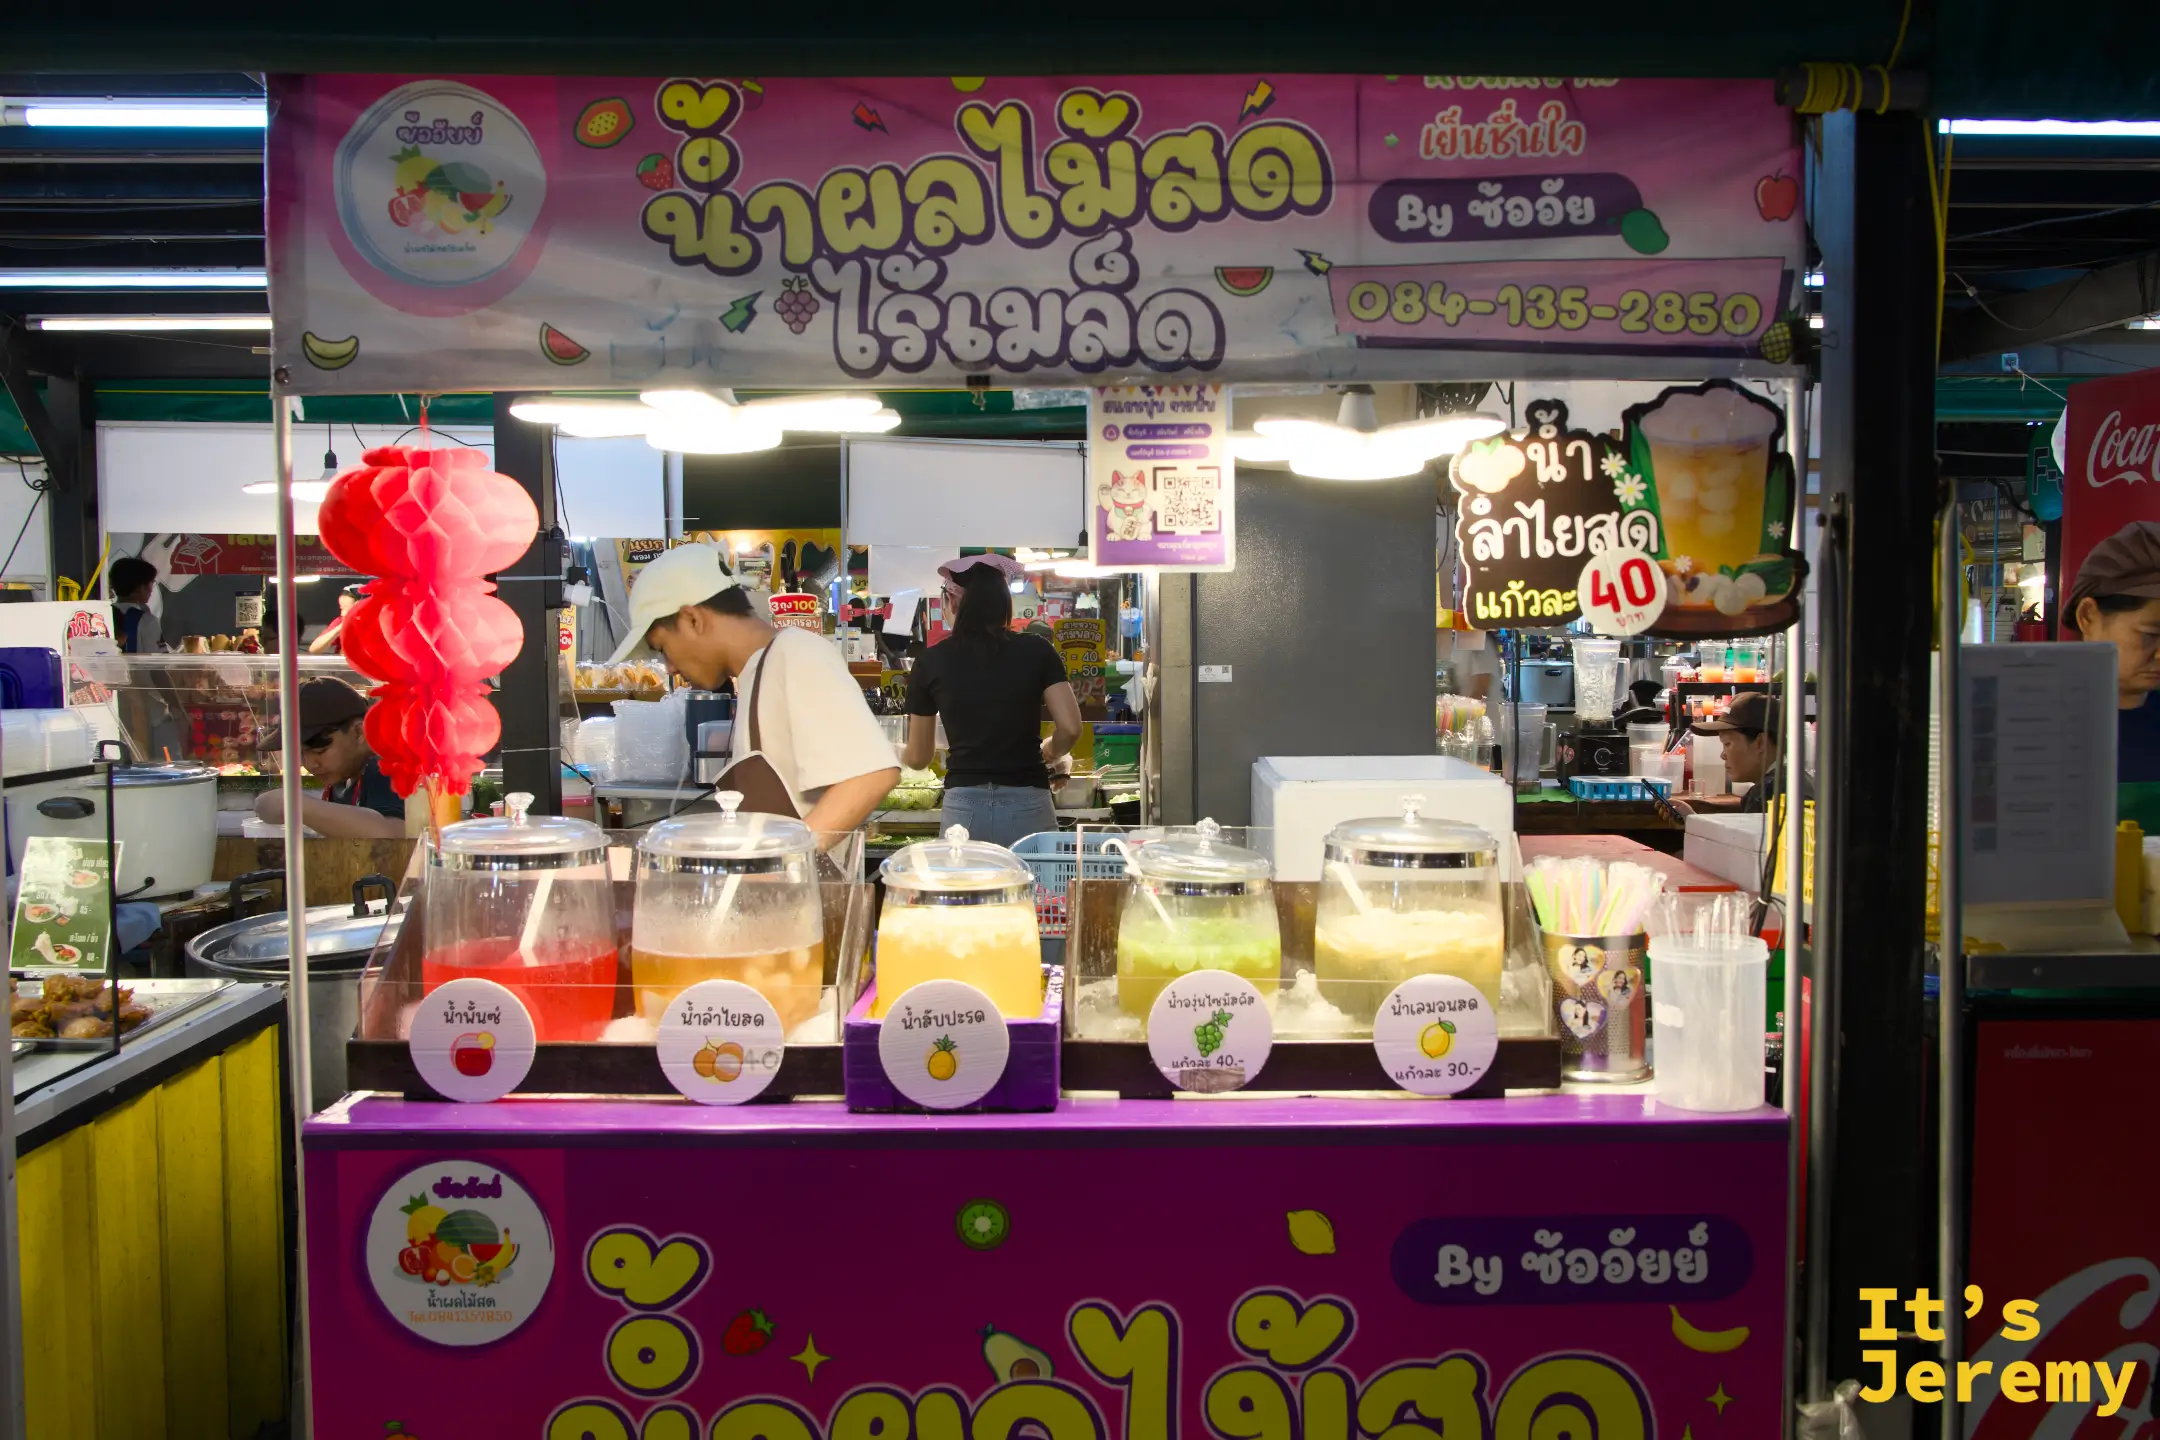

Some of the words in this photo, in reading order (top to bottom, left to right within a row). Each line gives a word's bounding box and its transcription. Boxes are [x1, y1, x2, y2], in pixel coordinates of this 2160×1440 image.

[1420, 99, 1586, 159] เย็นชื่นใจ
[641, 78, 1334, 276] น้ำผลไม้สด
[1395, 194, 1453, 237] By
[808, 226, 1226, 379] ไร้เมล็ด
[1346, 280, 1763, 337] 084-135-2850
[1527, 408, 1593, 482] น้ำ
[1468, 497, 1659, 561] ลำไยสด
[1475, 580, 1577, 620] แก้วละ
[1591, 558, 1656, 613] 40
[1616, 612, 1645, 627] บาท
[1083, 651, 1098, 662] 40
[1083, 665, 1099, 677] 50
[680, 1001, 765, 1027] น้ำลำไยสด
[901, 1005, 986, 1030] น้ำสับปะรด
[1391, 994, 1478, 1016] น้ำเลมอนสด
[1172, 1056, 1211, 1068] แก้วละ
[1215, 1054, 1244, 1068] 40.-
[1395, 1065, 1441, 1081] แก้วละ
[1448, 1062, 1481, 1077] 30.-
[1434, 1244, 1502, 1295] By
[427, 1288, 496, 1309] น้ำผลไม้สด
